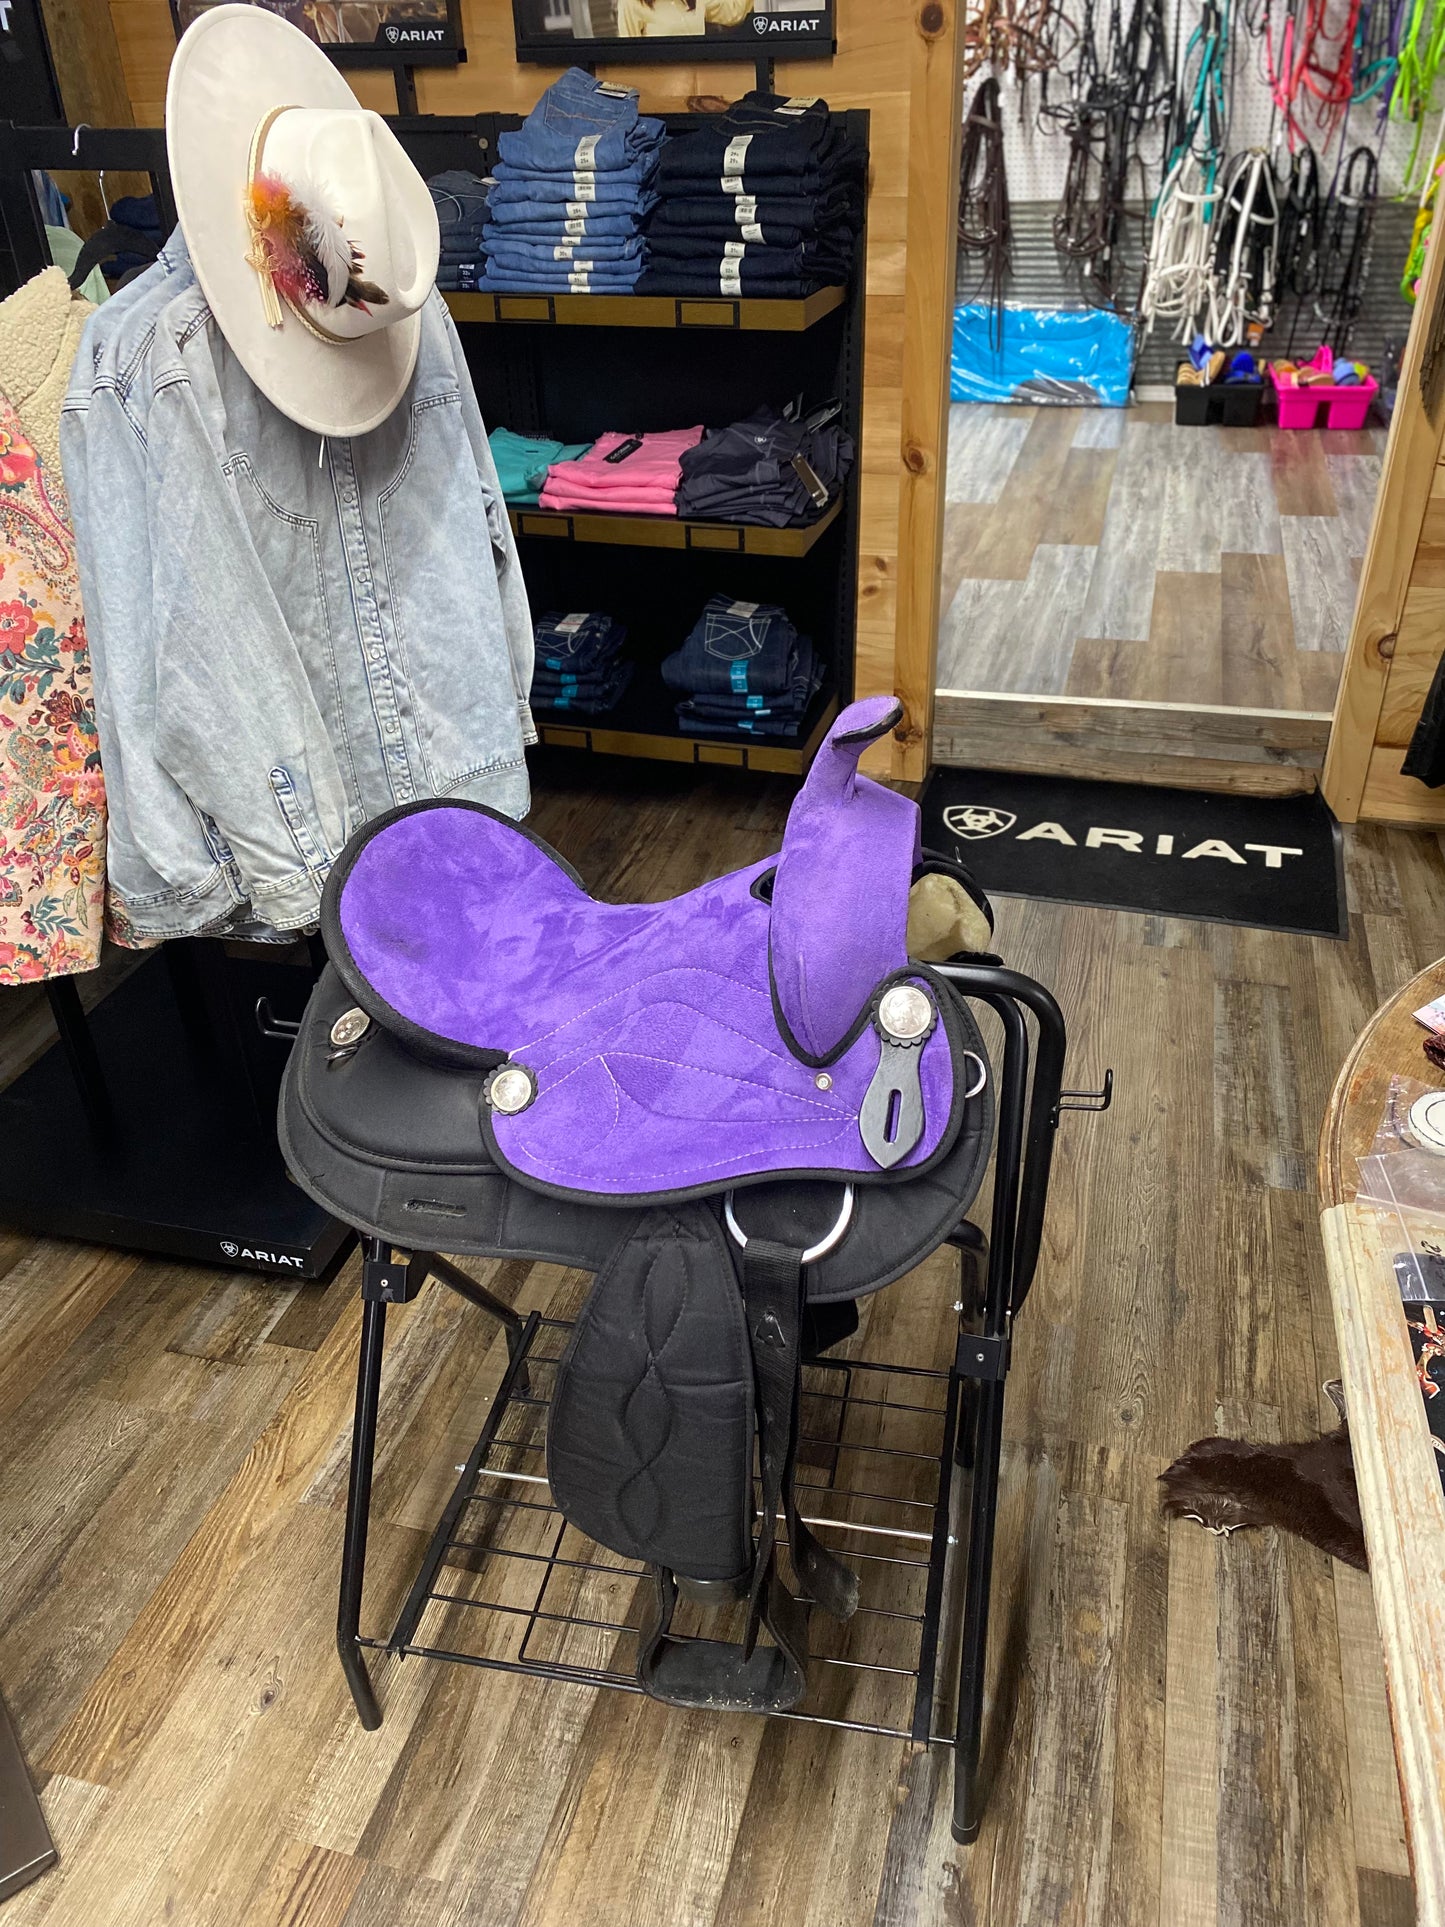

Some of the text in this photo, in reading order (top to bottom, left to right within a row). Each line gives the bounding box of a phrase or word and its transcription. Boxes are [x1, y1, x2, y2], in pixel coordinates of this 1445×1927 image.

[768, 19, 820, 32] ARIAT
[400, 30, 445, 41] ARIAT
[1015, 821, 1303, 868] ARIAT
[241, 1248, 304, 1268] ARIAT
